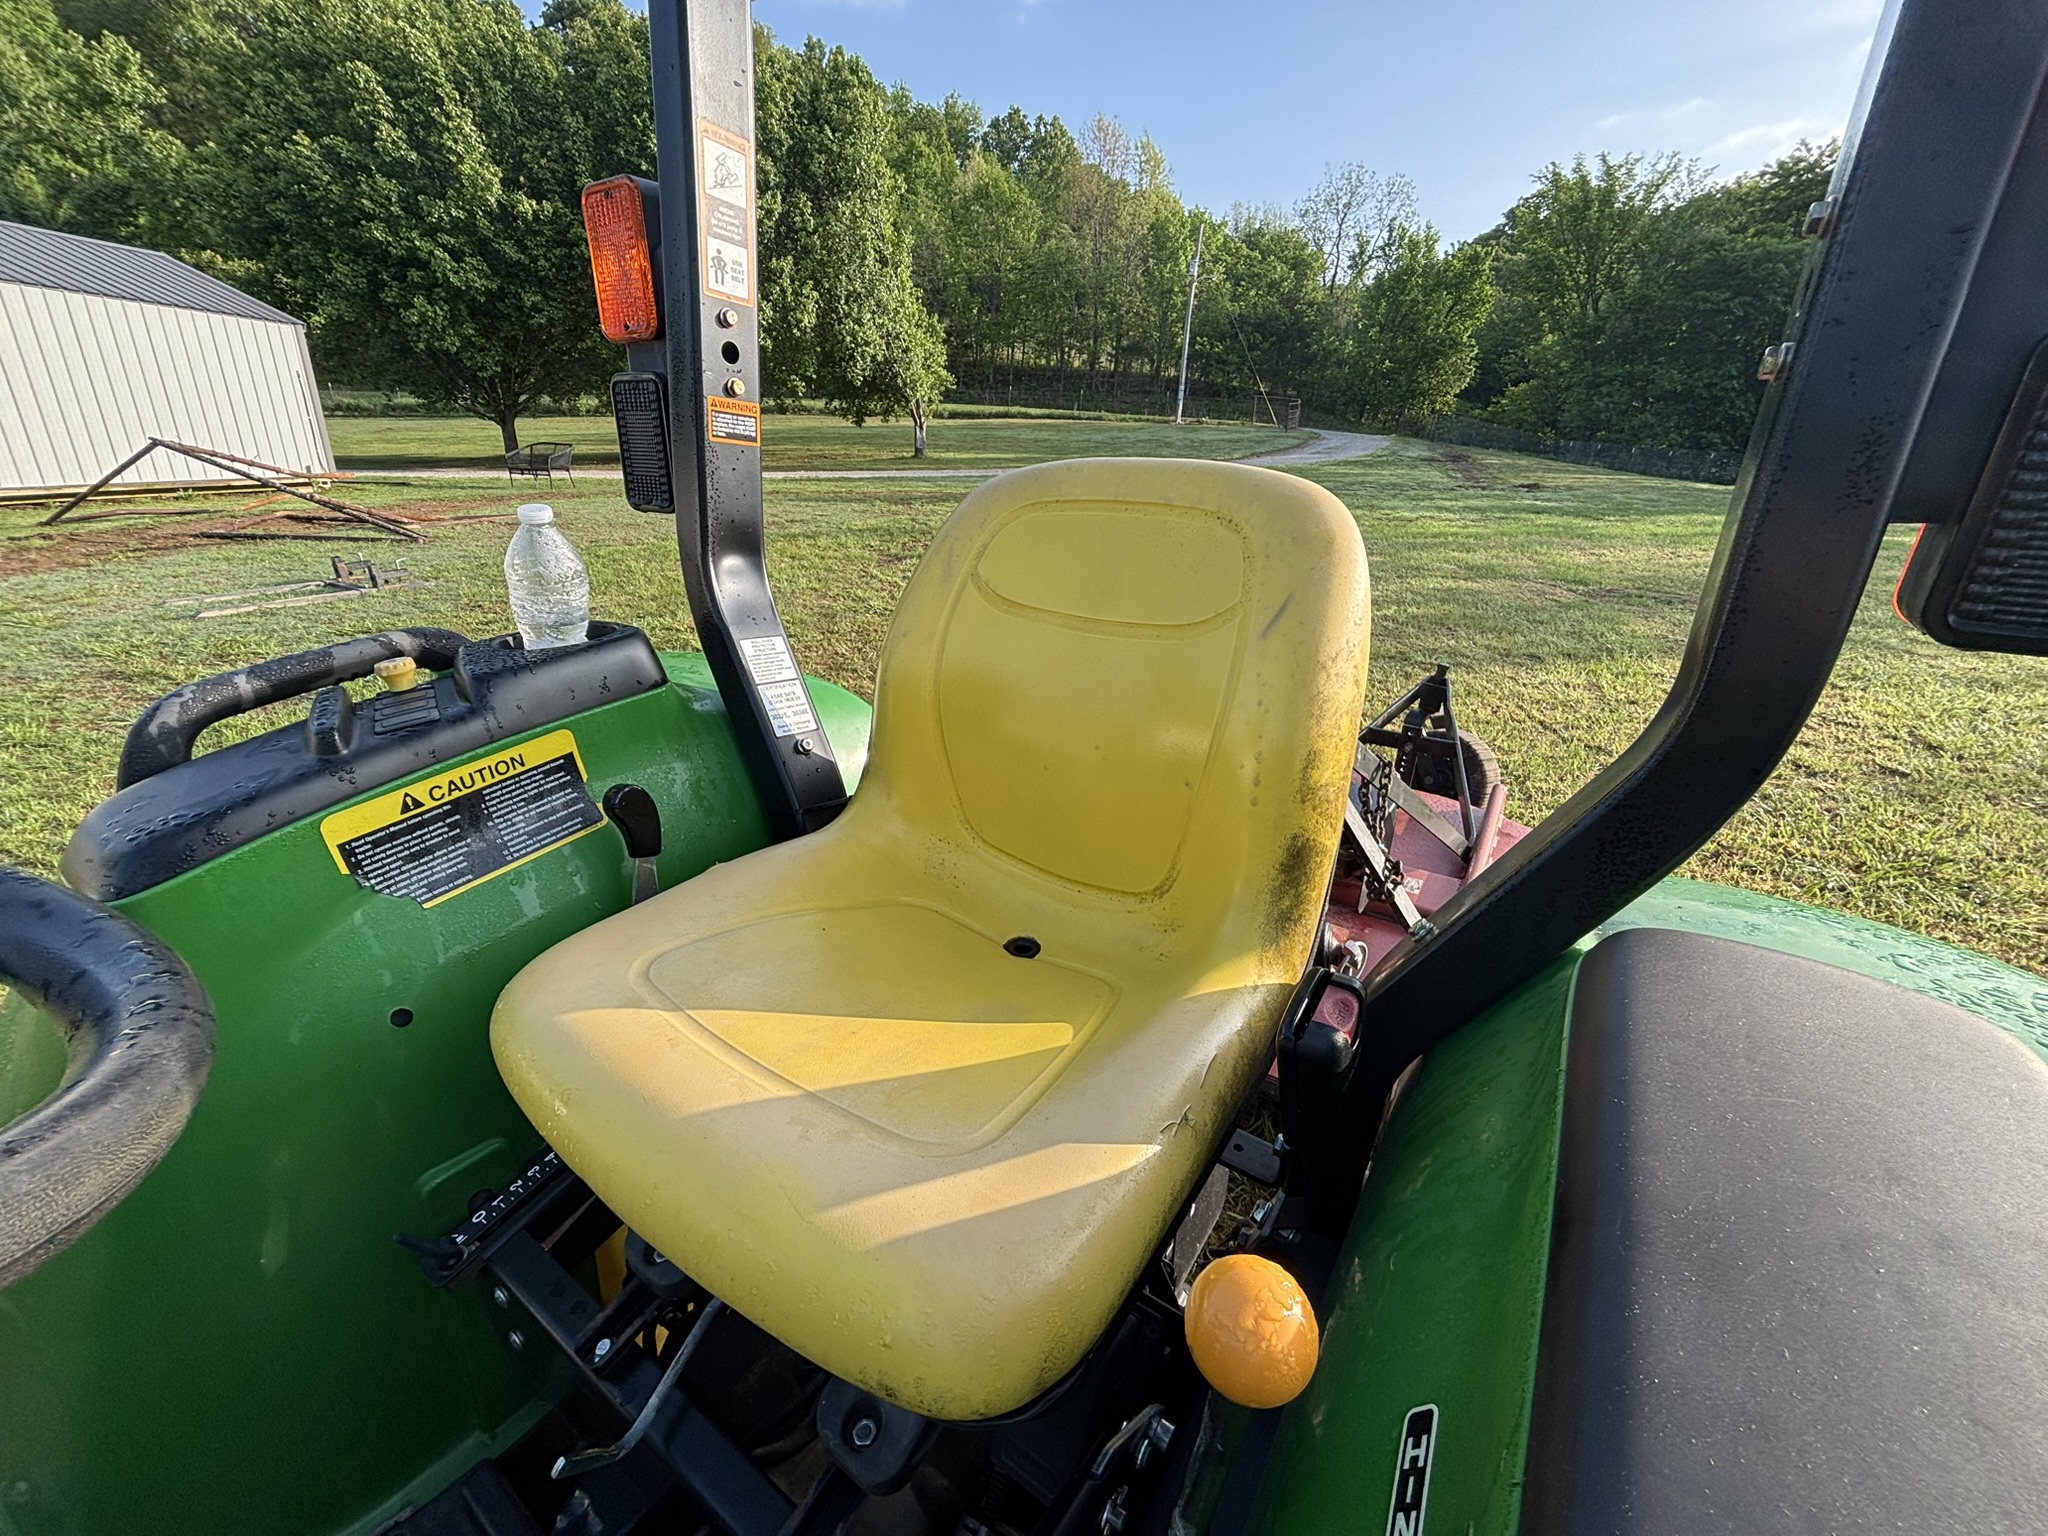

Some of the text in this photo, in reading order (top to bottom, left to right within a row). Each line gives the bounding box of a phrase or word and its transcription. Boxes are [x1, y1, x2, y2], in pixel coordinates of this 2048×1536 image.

[718, 400, 758, 414] WARNING
[429, 753, 526, 802] CAUTION
[492, 1195, 504, 1206] 1
[510, 1180, 522, 1191] 2
[528, 1166, 540, 1176] 3
[544, 1152, 556, 1162] 4
